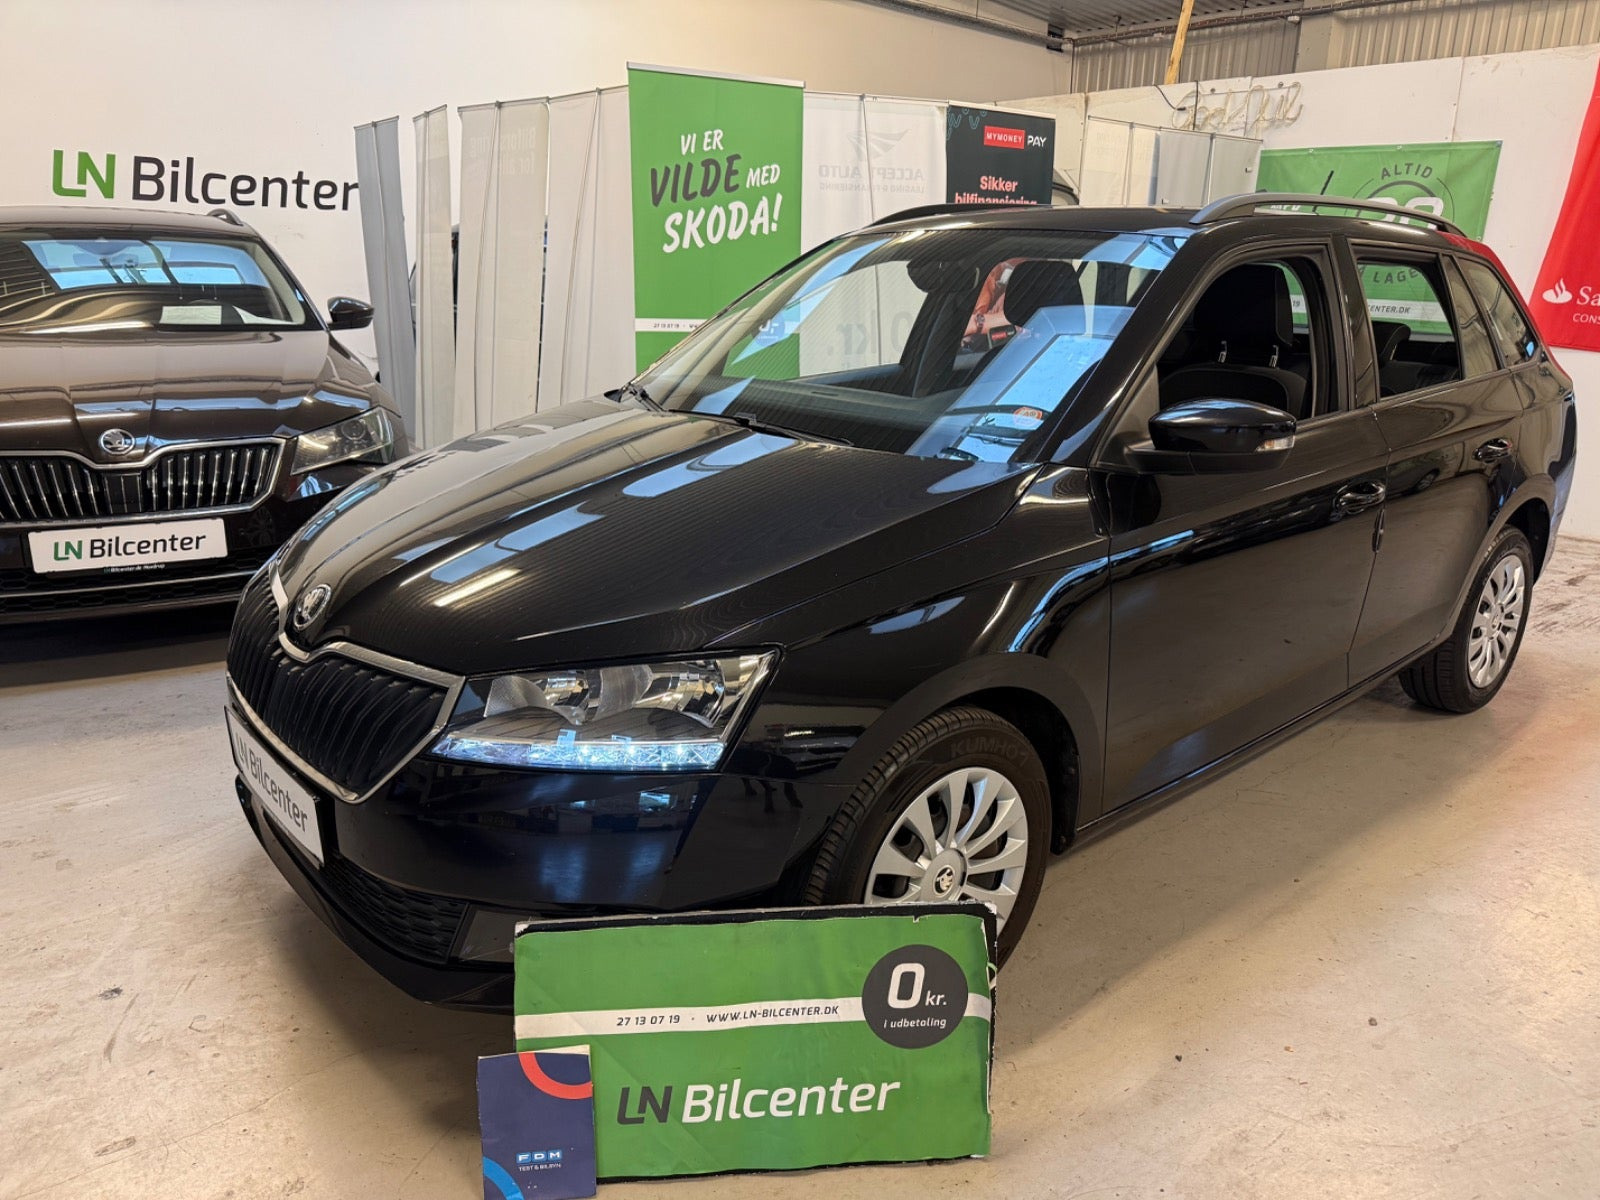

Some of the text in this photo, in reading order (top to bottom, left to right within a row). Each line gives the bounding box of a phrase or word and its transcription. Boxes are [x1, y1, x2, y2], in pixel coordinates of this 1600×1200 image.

[681, 129, 724, 155] VI ER
[986, 132, 1046, 147] MYMONEY PAY
[52, 149, 359, 211] LN Bilcenter
[650, 154, 781, 207] VILDE MED
[979, 175, 1018, 192] Sikker
[1381, 162, 1433, 180] ALTID
[663, 193, 783, 253] SKODA!
[53, 534, 207, 561] LN Bilcenter
[249, 748, 308, 832] Bilcenter
[887, 962, 947, 1010] 0 kr.
[616, 1005, 839, 1026] 27 13 07 19 WWW.LN-BILCENTER.DK
[890, 1018, 947, 1029] udbetaling
[617, 1077, 901, 1125] LN Bilcenter
[518, 1151, 561, 1162] FDM
